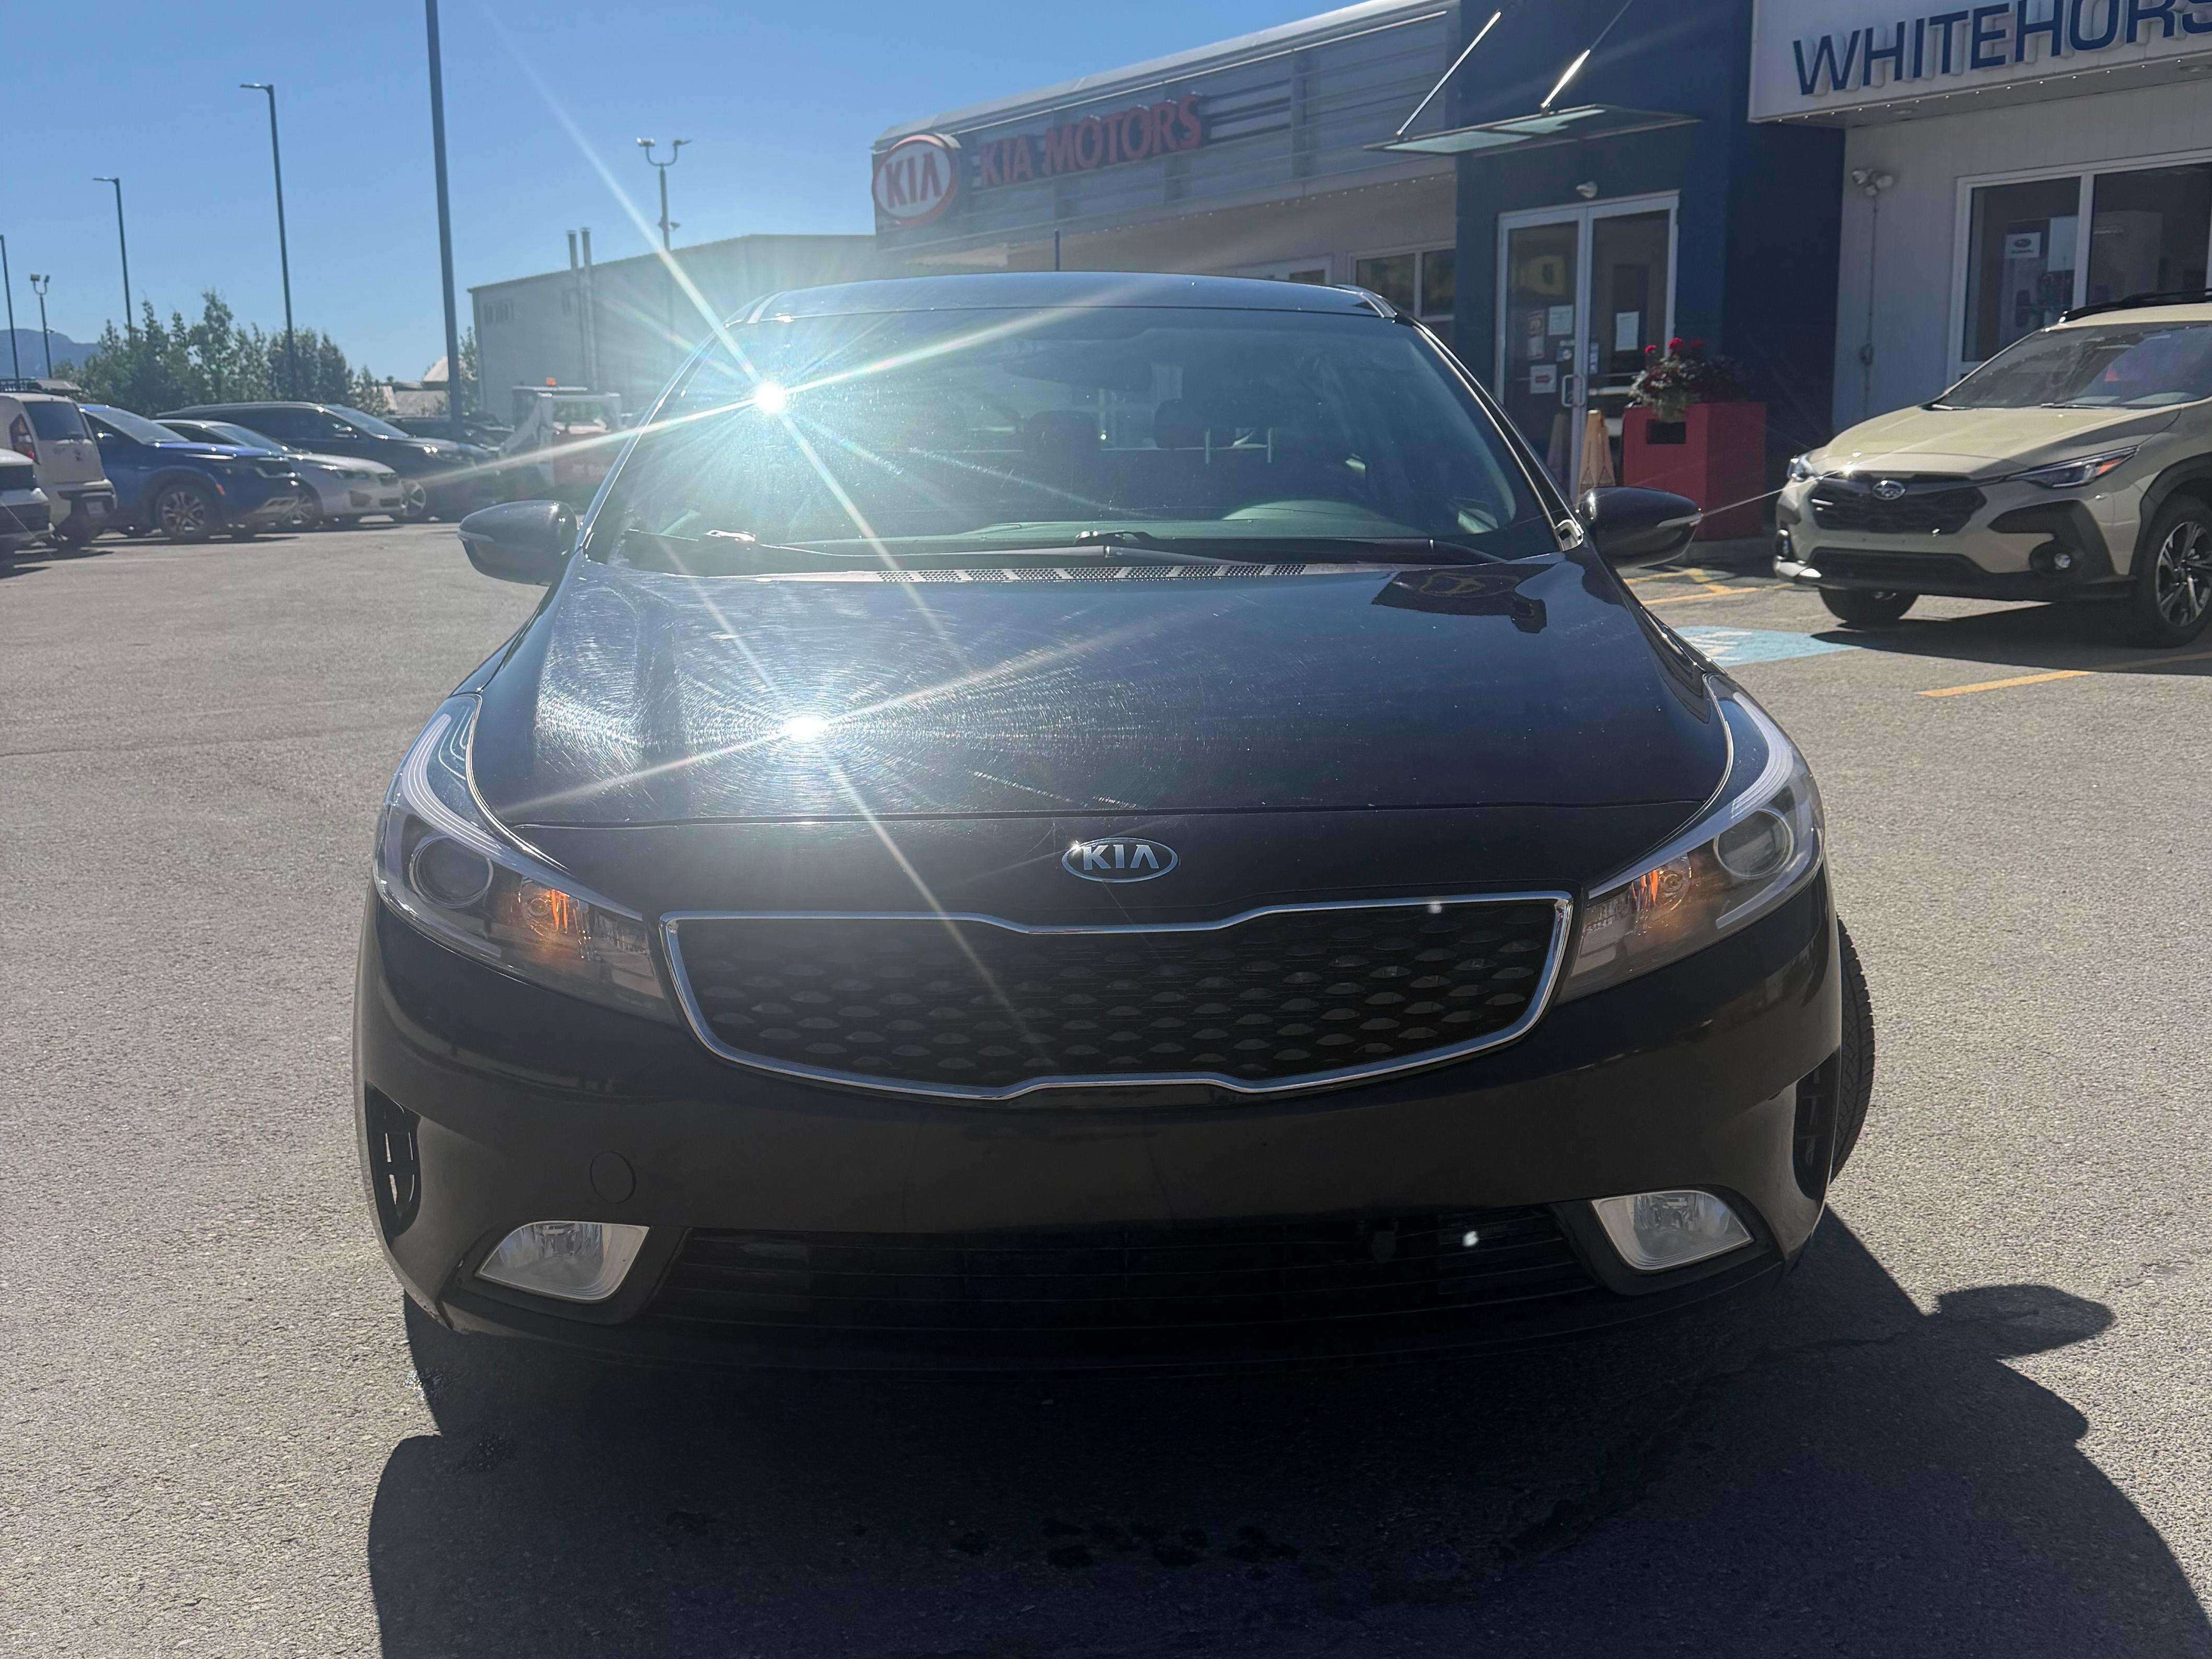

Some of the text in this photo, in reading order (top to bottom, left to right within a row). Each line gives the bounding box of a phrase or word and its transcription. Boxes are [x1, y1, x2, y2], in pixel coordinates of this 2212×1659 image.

[981, 93, 1200, 188] KIA MOTORS
[885, 151, 942, 208] KIA
[1083, 844, 1159, 870] KIA
